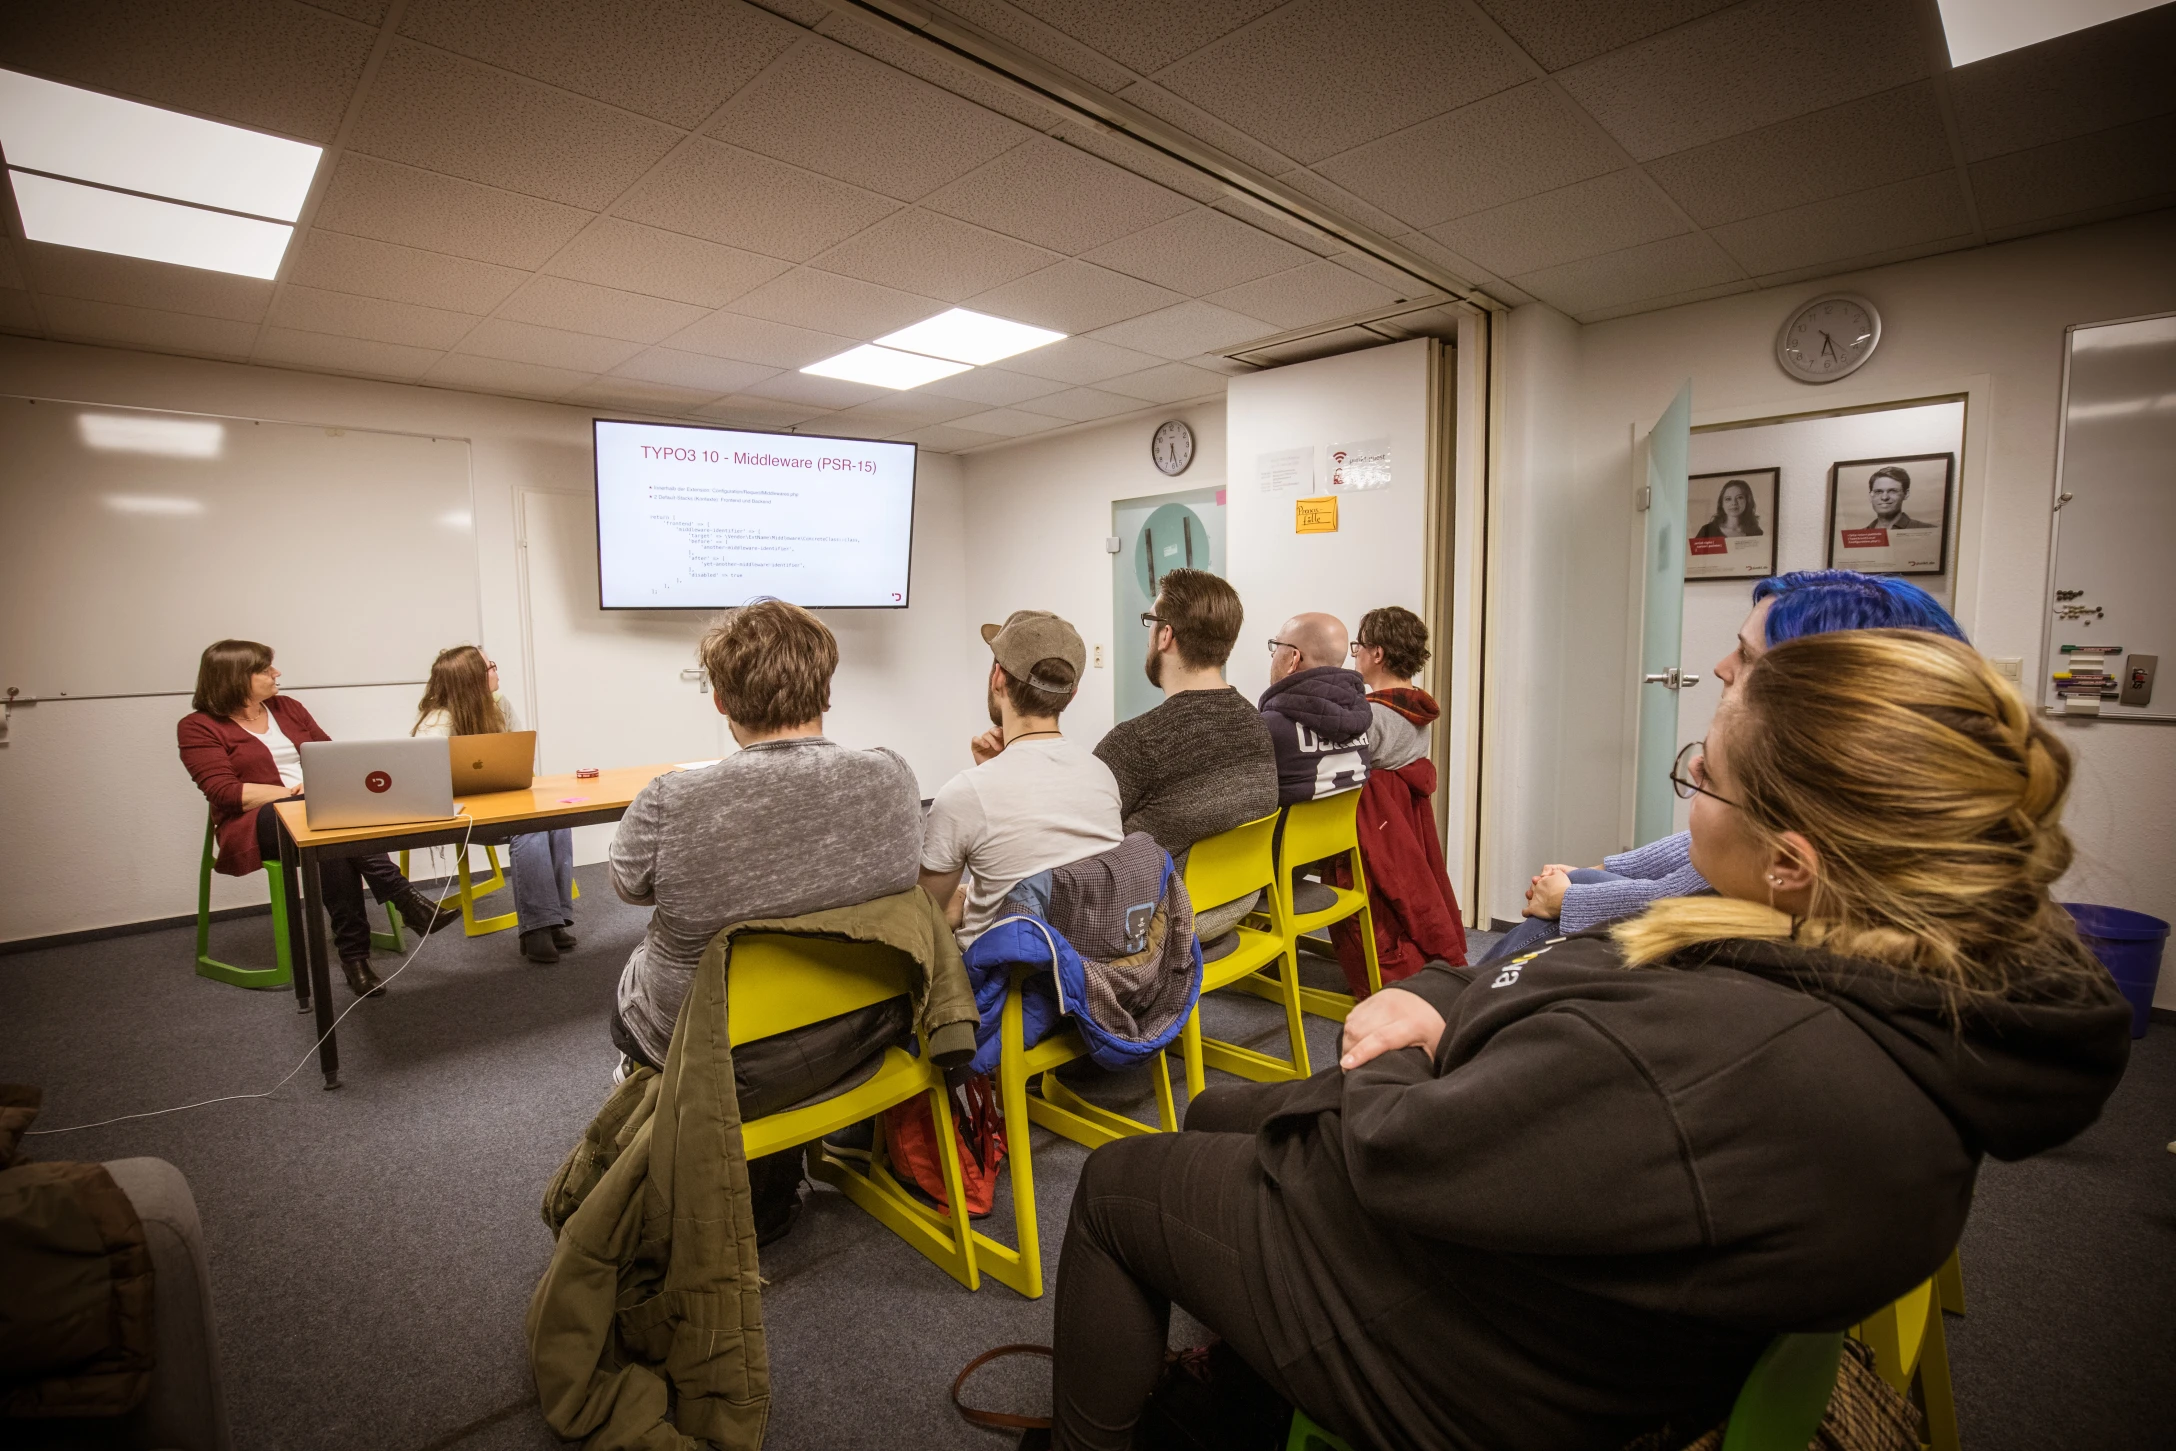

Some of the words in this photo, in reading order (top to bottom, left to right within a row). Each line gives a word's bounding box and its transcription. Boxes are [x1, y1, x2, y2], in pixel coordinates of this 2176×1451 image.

[1824, 306, 1833, 315] 12
[1798, 324, 1807, 333] 10
[640, 445, 697, 462] TYPO3
[702, 450, 719, 463] 10
[734, 452, 813, 469] Middleware
[817, 457, 877, 475] (PSR-15)
